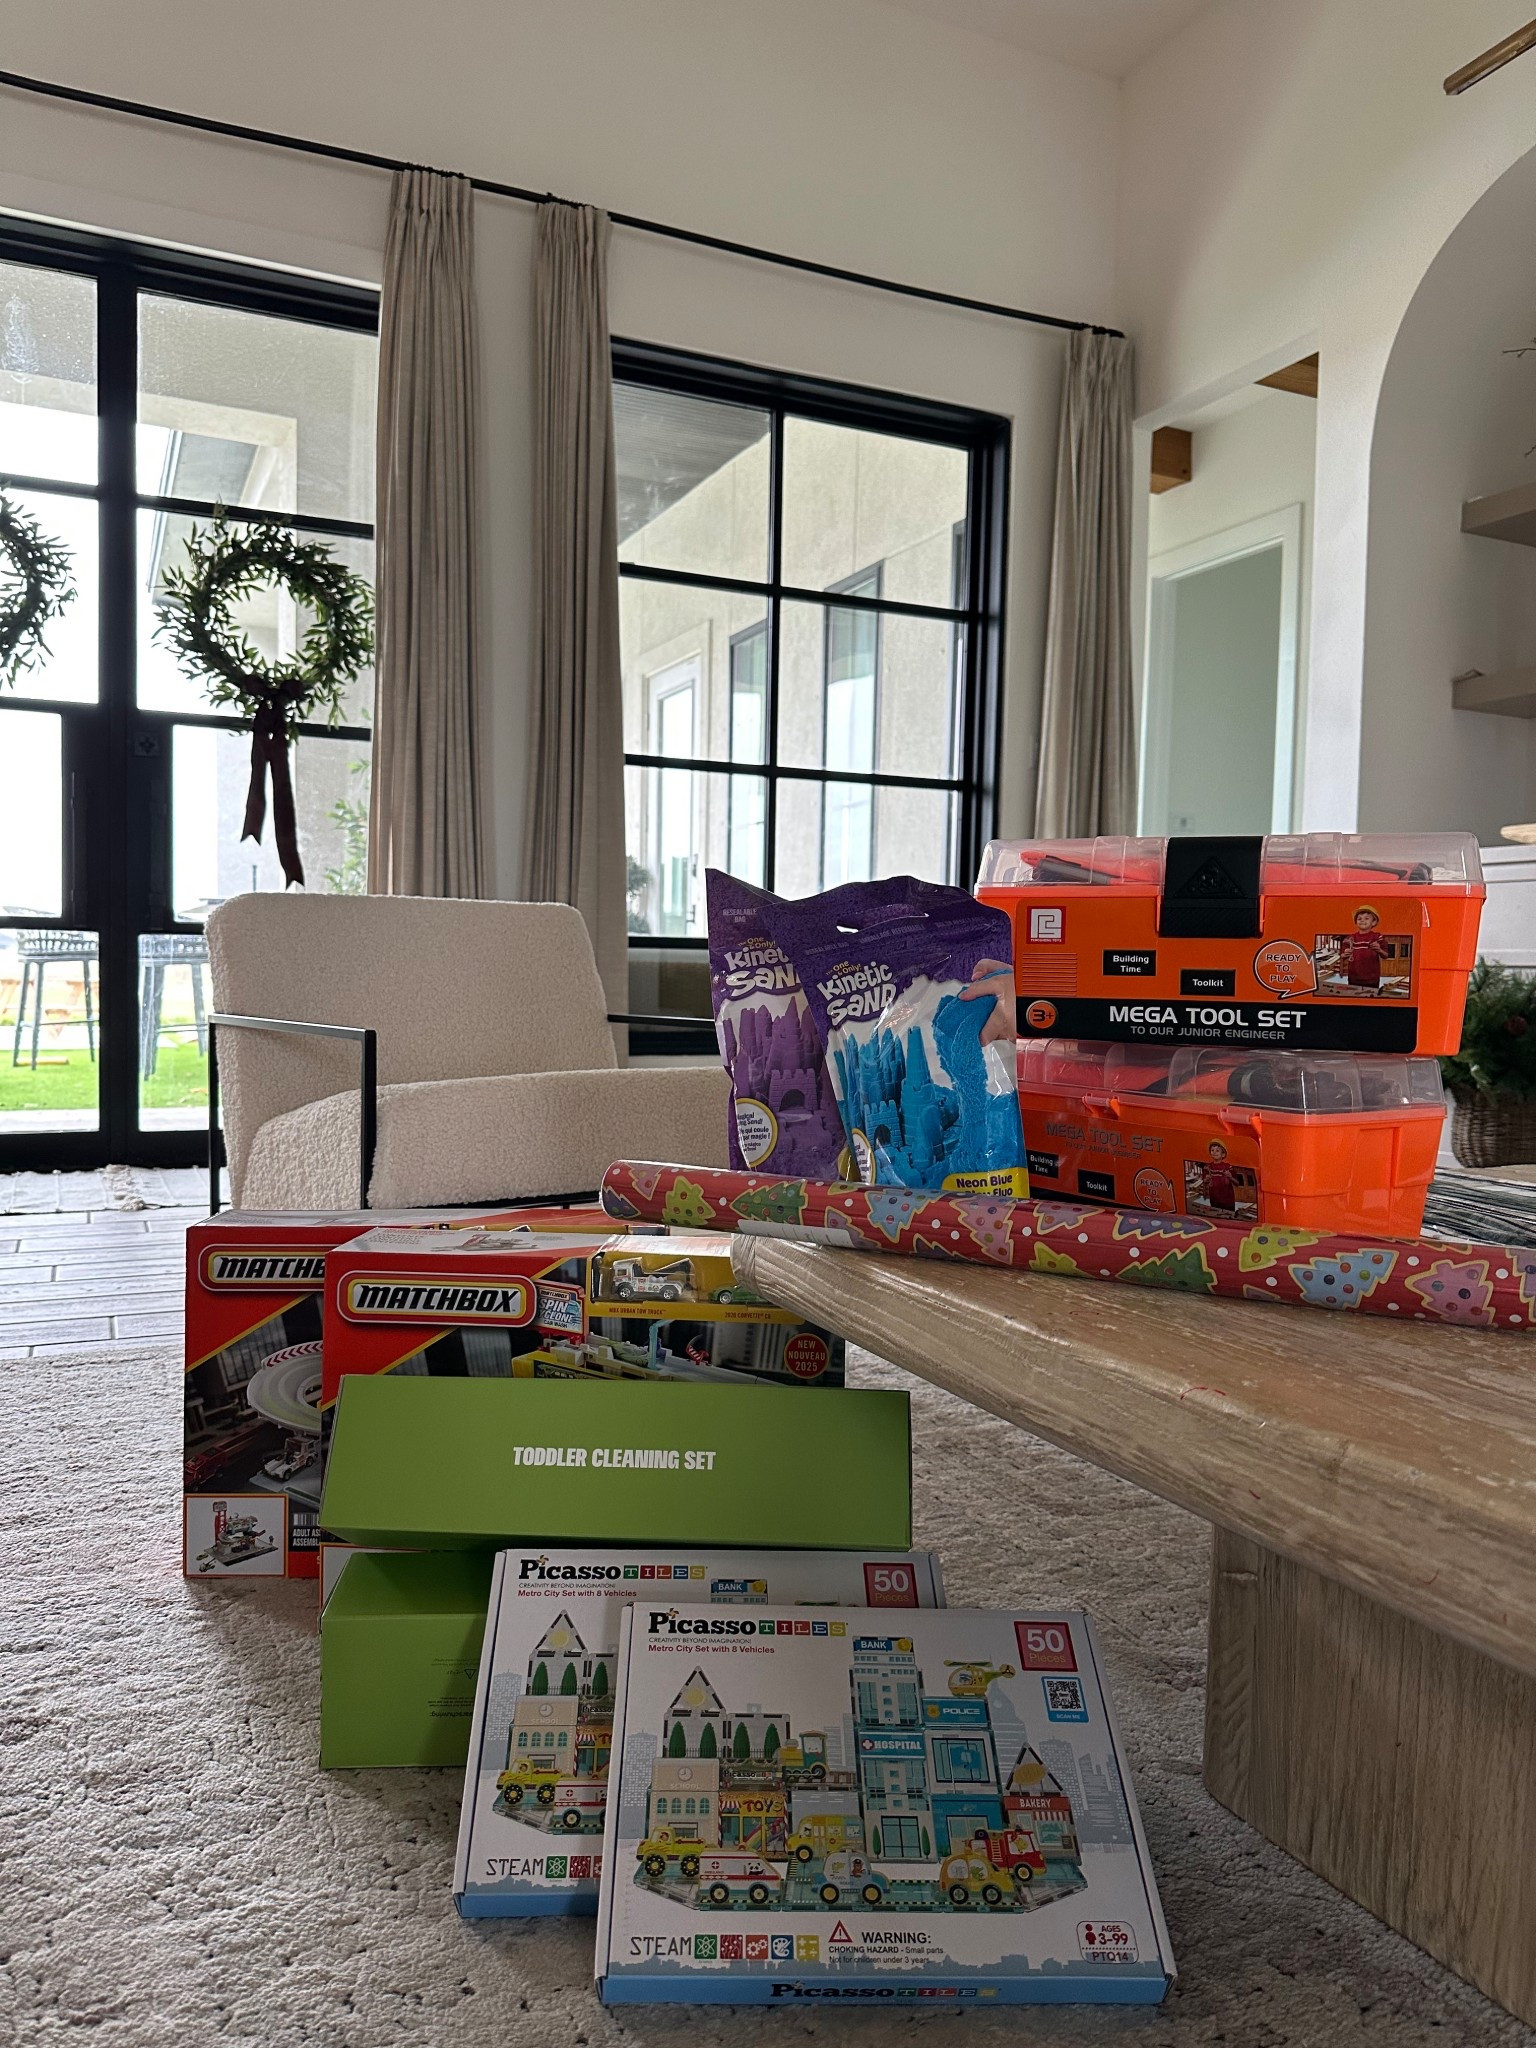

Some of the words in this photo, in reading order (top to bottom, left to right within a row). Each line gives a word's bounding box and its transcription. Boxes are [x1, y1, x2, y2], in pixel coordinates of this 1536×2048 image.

[722, 908, 757, 916] RESEALABLE
[756, 940, 776, 948] Only!
[1113, 955, 1149, 964] Building
[1266, 953, 1301, 962] READY
[833, 960, 849, 972] One
[842, 963, 862, 974] Only!
[1120, 965, 1141, 973] Time
[1275, 964, 1290, 972] TO
[817, 961, 893, 1001] Kinetic
[1192, 978, 1224, 987] Toolkit
[1269, 974, 1296, 983] PLAY
[1032, 1009, 1054, 1022] 3+
[1109, 1006, 1178, 1024] MEGA
[1186, 1008, 1249, 1026] TOOL
[1257, 1010, 1307, 1029] SET
[1130, 1026, 1145, 1035] TO
[1149, 1026, 1174, 1036] OUR
[1178, 1027, 1221, 1038] JUNIOR
[1225, 1029, 1286, 1040] ENGINEER
[1045, 1123, 1086, 1141] MEGA
[1090, 1128, 1127, 1148] TOOL
[1131, 1135, 1164, 1153] SET
[1030, 1154, 1053, 1167] Building
[1034, 1165, 1049, 1174] Time
[956, 1178, 987, 1189] Neon
[990, 1174, 1013, 1187] Blue
[1086, 1181, 1108, 1192] Toolkit
[1140, 1178, 1163, 1188] READY
[992, 1187, 1013, 1197] Fluo
[1147, 1188, 1157, 1196] TO
[1144, 1196, 1161, 1205] PLAY
[356, 1285, 520, 1313] MATCHBOX
[554, 1321, 568, 1329] WASH
[797, 1340, 816, 1349] NEW
[788, 1351, 826, 1360] NOUVEAU
[795, 1361, 818, 1372] 2025
[513, 1447, 588, 1467] TODDLER
[592, 1448, 680, 1469] CLEANING
[684, 1450, 716, 1470] SET
[293, 1529, 310, 1537] ADULT
[292, 1537, 320, 1547] ASSEMBL
[874, 1569, 909, 1592] 50
[718, 1583, 743, 1591] BANK
[544, 1590, 561, 1598] City
[874, 1592, 910, 1602] Pieces
[861, 1641, 887, 1649] BANK
[1027, 1629, 1065, 1653] 50
[676, 1645, 692, 1653] City
[711, 1645, 730, 1653] with
[740, 1645, 775, 1654] Vehicles
[1029, 1653, 1065, 1663] Pieces
[874, 1740, 922, 1750] HOSPITAL
[724, 1770, 756, 1778] Picasso
[743, 1799, 784, 1813] TOYS
[1020, 1798, 1051, 1808] BAKERY
[486, 1858, 544, 1876] STEAM
[861, 1932, 932, 1944] WARNING:
[1098, 1933, 1129, 1945] 3-99
[630, 1936, 692, 1956] STEAM
[828, 1946, 865, 1954] CHOKING
[867, 1946, 899, 1954] HAZARD
[905, 1946, 924, 1954] Small
[926, 1947, 944, 1955] parts
[1092, 1951, 1129, 1962] PTQ14
